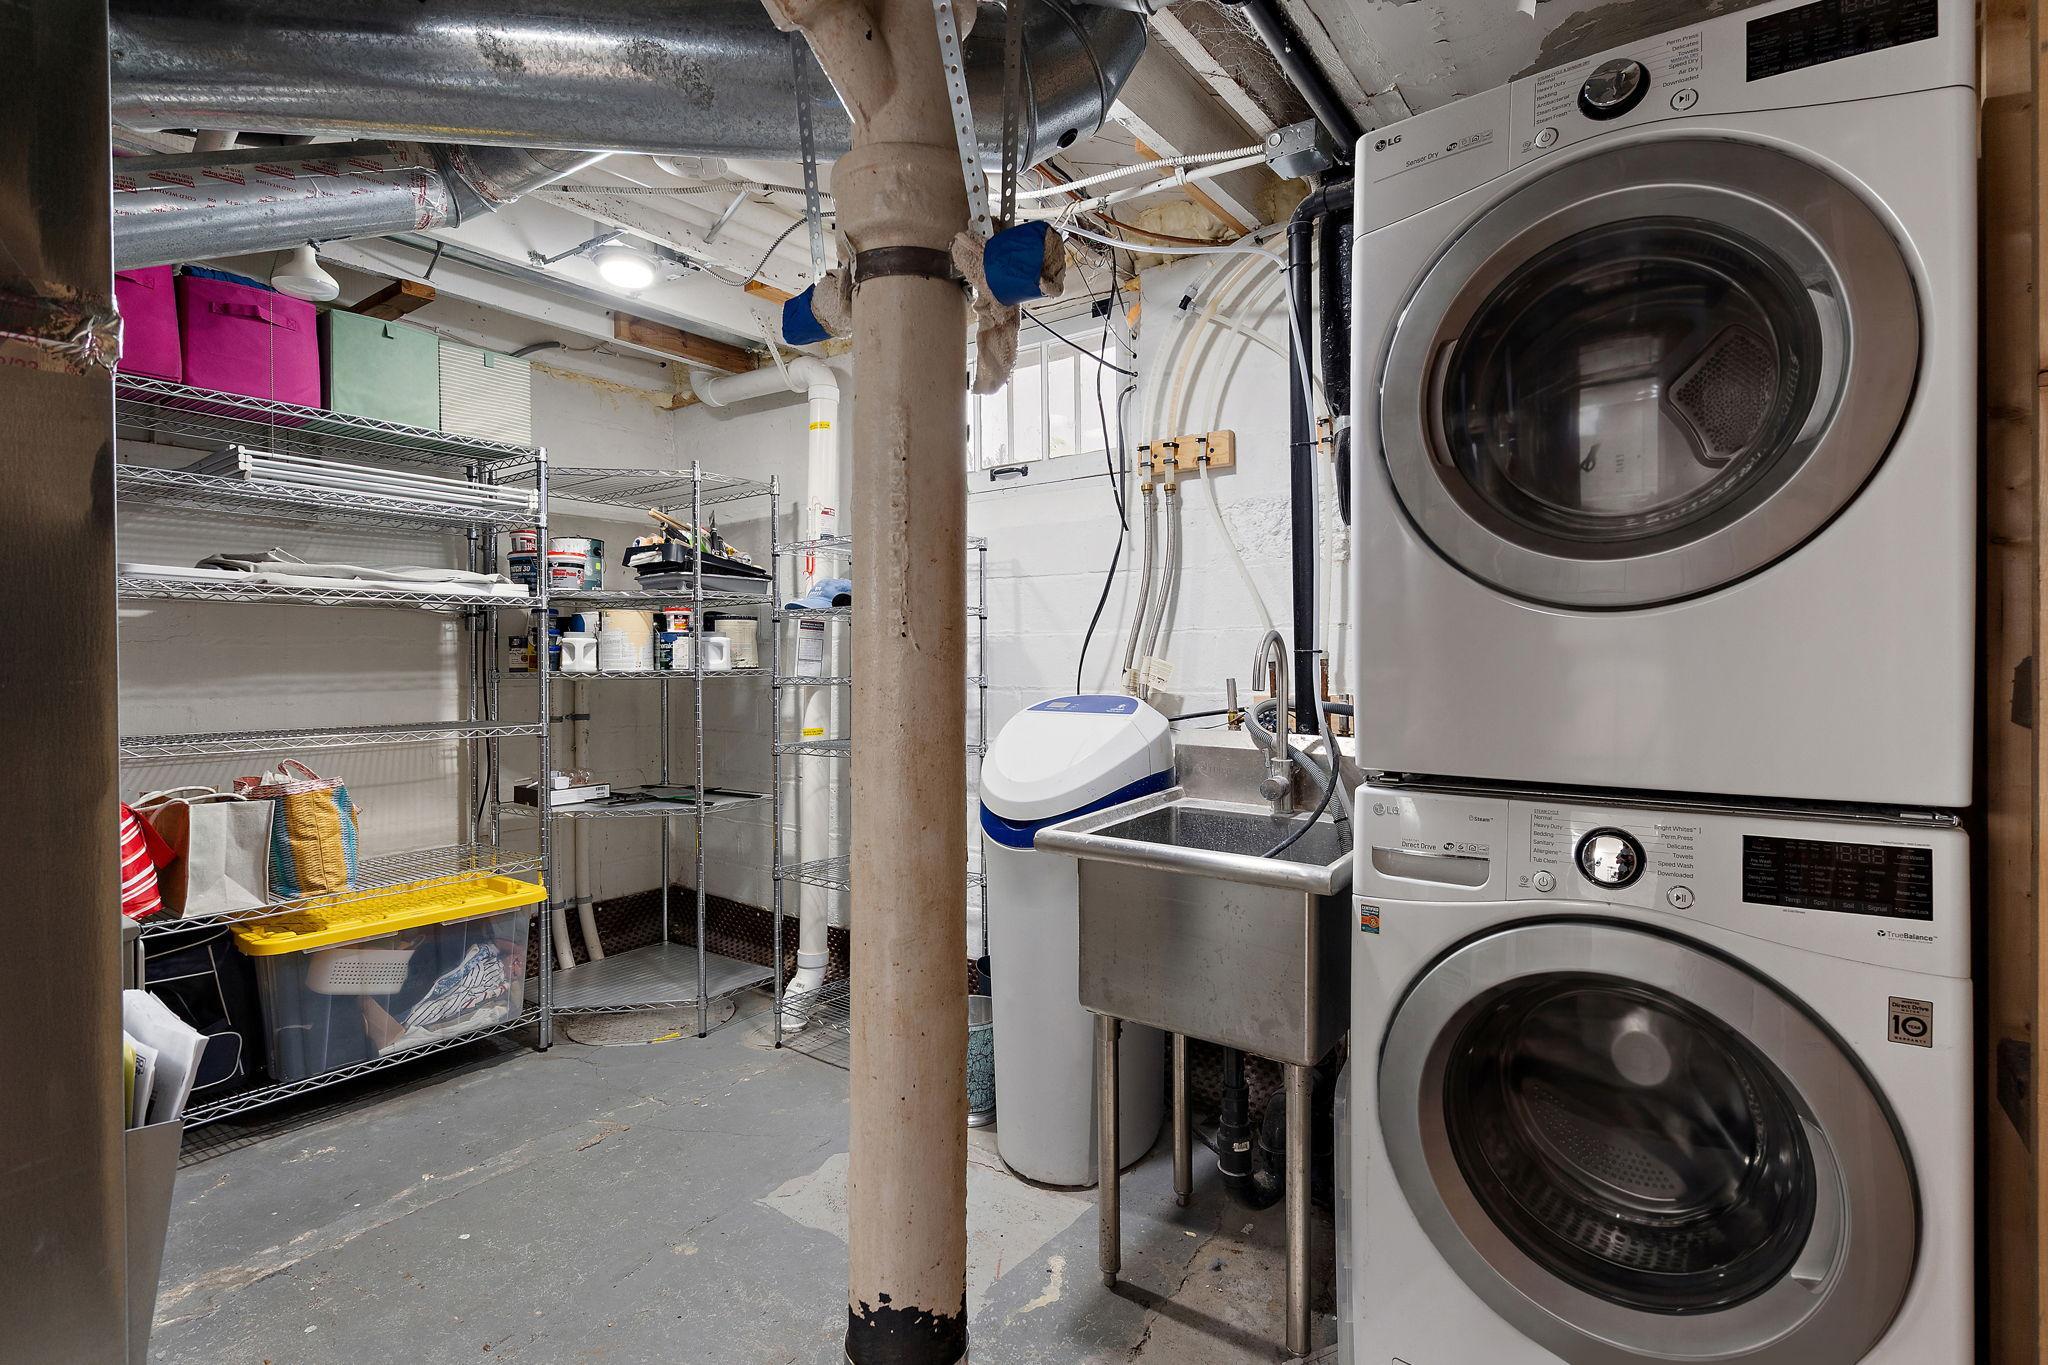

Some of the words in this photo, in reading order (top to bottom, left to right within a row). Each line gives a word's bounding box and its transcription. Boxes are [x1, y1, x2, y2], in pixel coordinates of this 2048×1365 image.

[1682, 33, 1698, 41] Press
[1672, 40, 1699, 52] Delicates
[1678, 48, 1699, 56] Towels
[1537, 77, 1556, 86] Normal
[1662, 74, 1699, 88] Downloaded
[1536, 94, 1570, 108] Antibacterial
[1387, 134, 1402, 147] LG
[1405, 156, 1427, 168] Sensor
[1427, 151, 1439, 160] Dry
[1386, 806, 1400, 815] LG
[1402, 841, 1420, 849] Direct
[1420, 842, 1436, 850] Drive
[1657, 870, 1694, 879] Downloaded
[1892, 1002, 1911, 1010] Direct
[1912, 1004, 1930, 1012] Drive
[1892, 1014, 1928, 1038] 10
